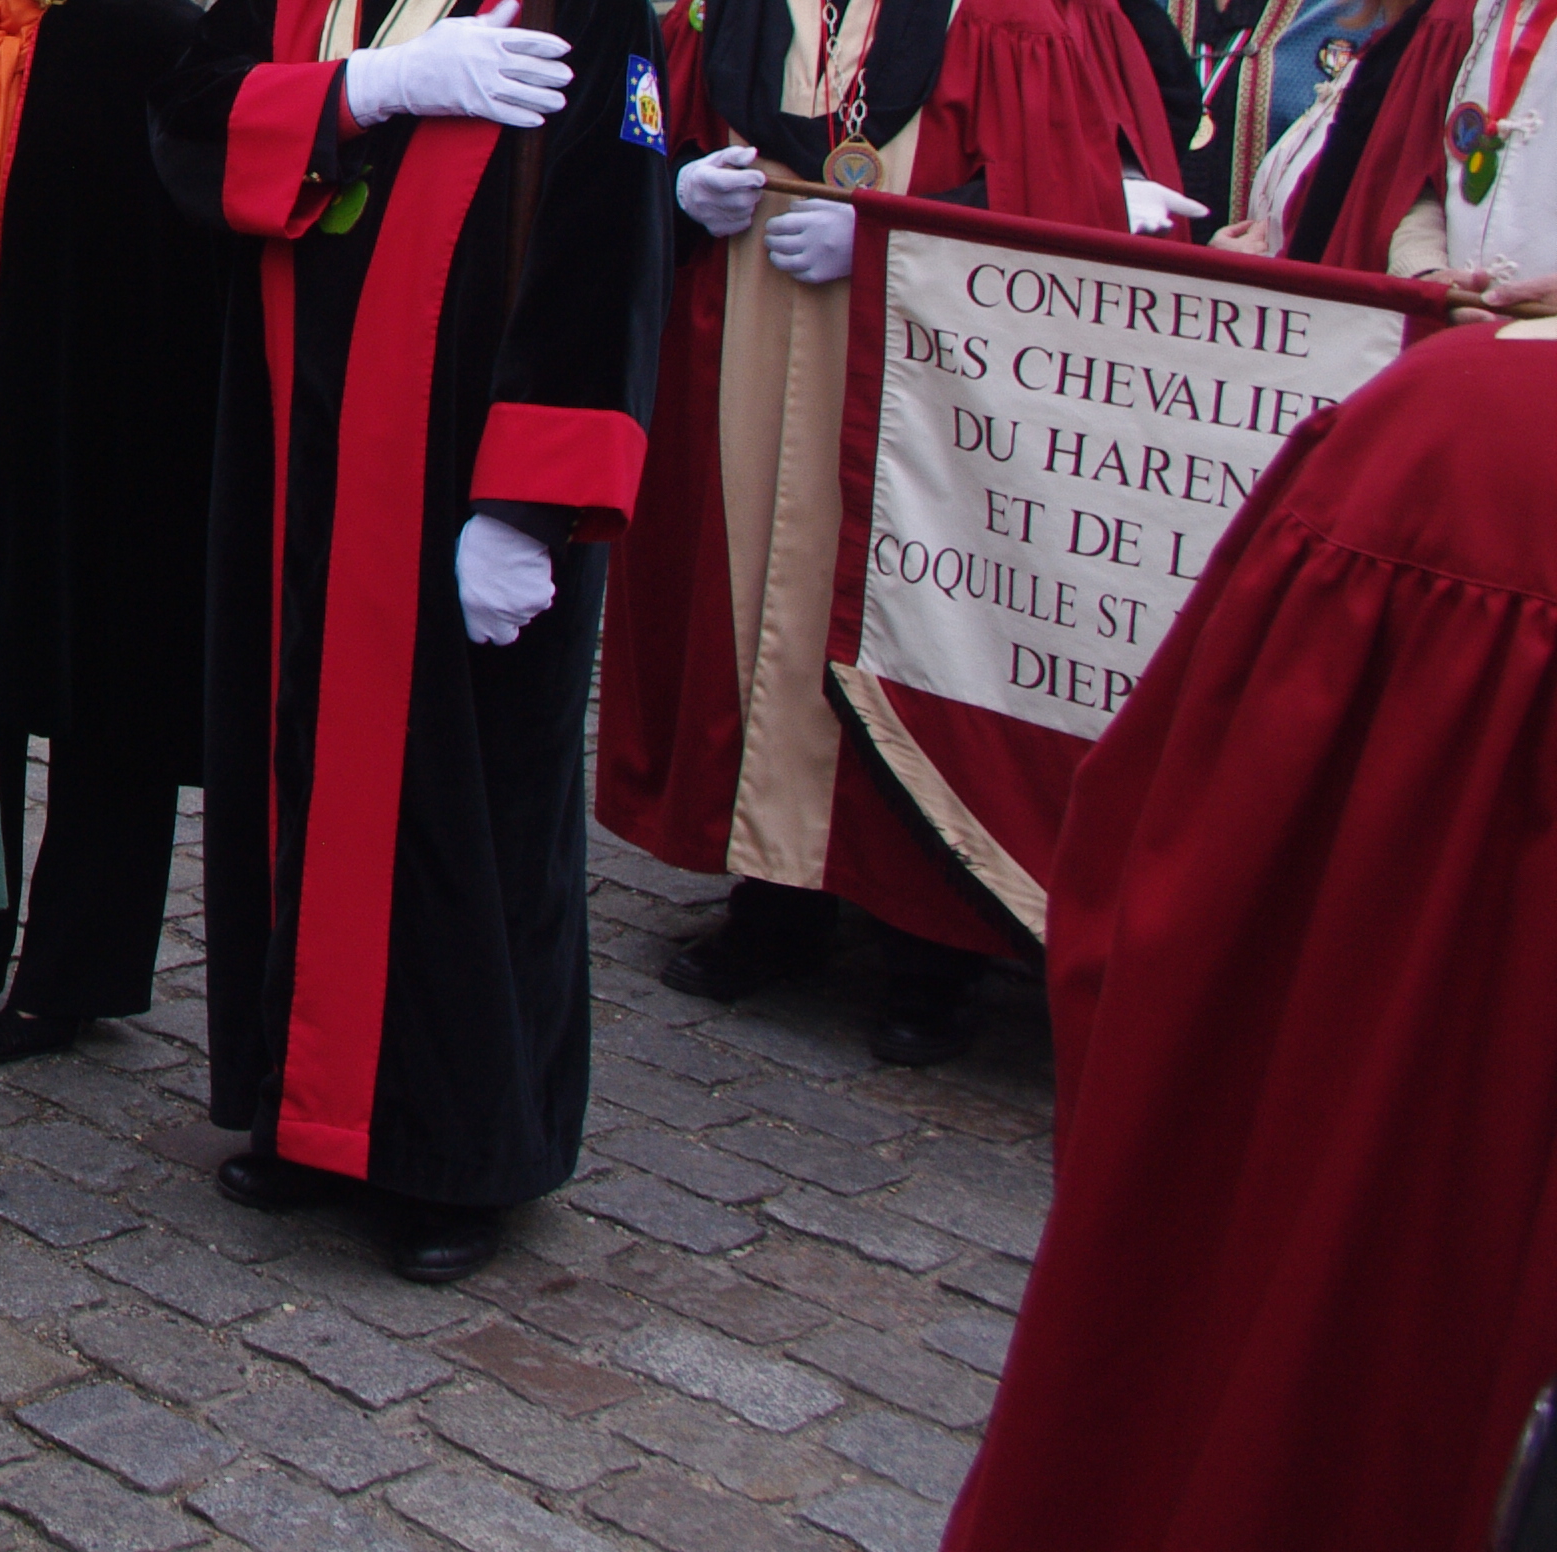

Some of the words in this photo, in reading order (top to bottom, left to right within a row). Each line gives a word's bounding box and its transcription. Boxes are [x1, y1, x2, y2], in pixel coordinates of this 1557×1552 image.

[966, 263, 1312, 358] CONFRERIE
[902, 320, 988, 380] DES
[951, 405, 1022, 462] DU
[984, 488, 1045, 544] ET
[1068, 509, 1143, 567] DE
[872, 532, 1077, 629] COQUILLE
[1096, 592, 1147, 645] ST
[1008, 642, 1137, 715] DIEP
